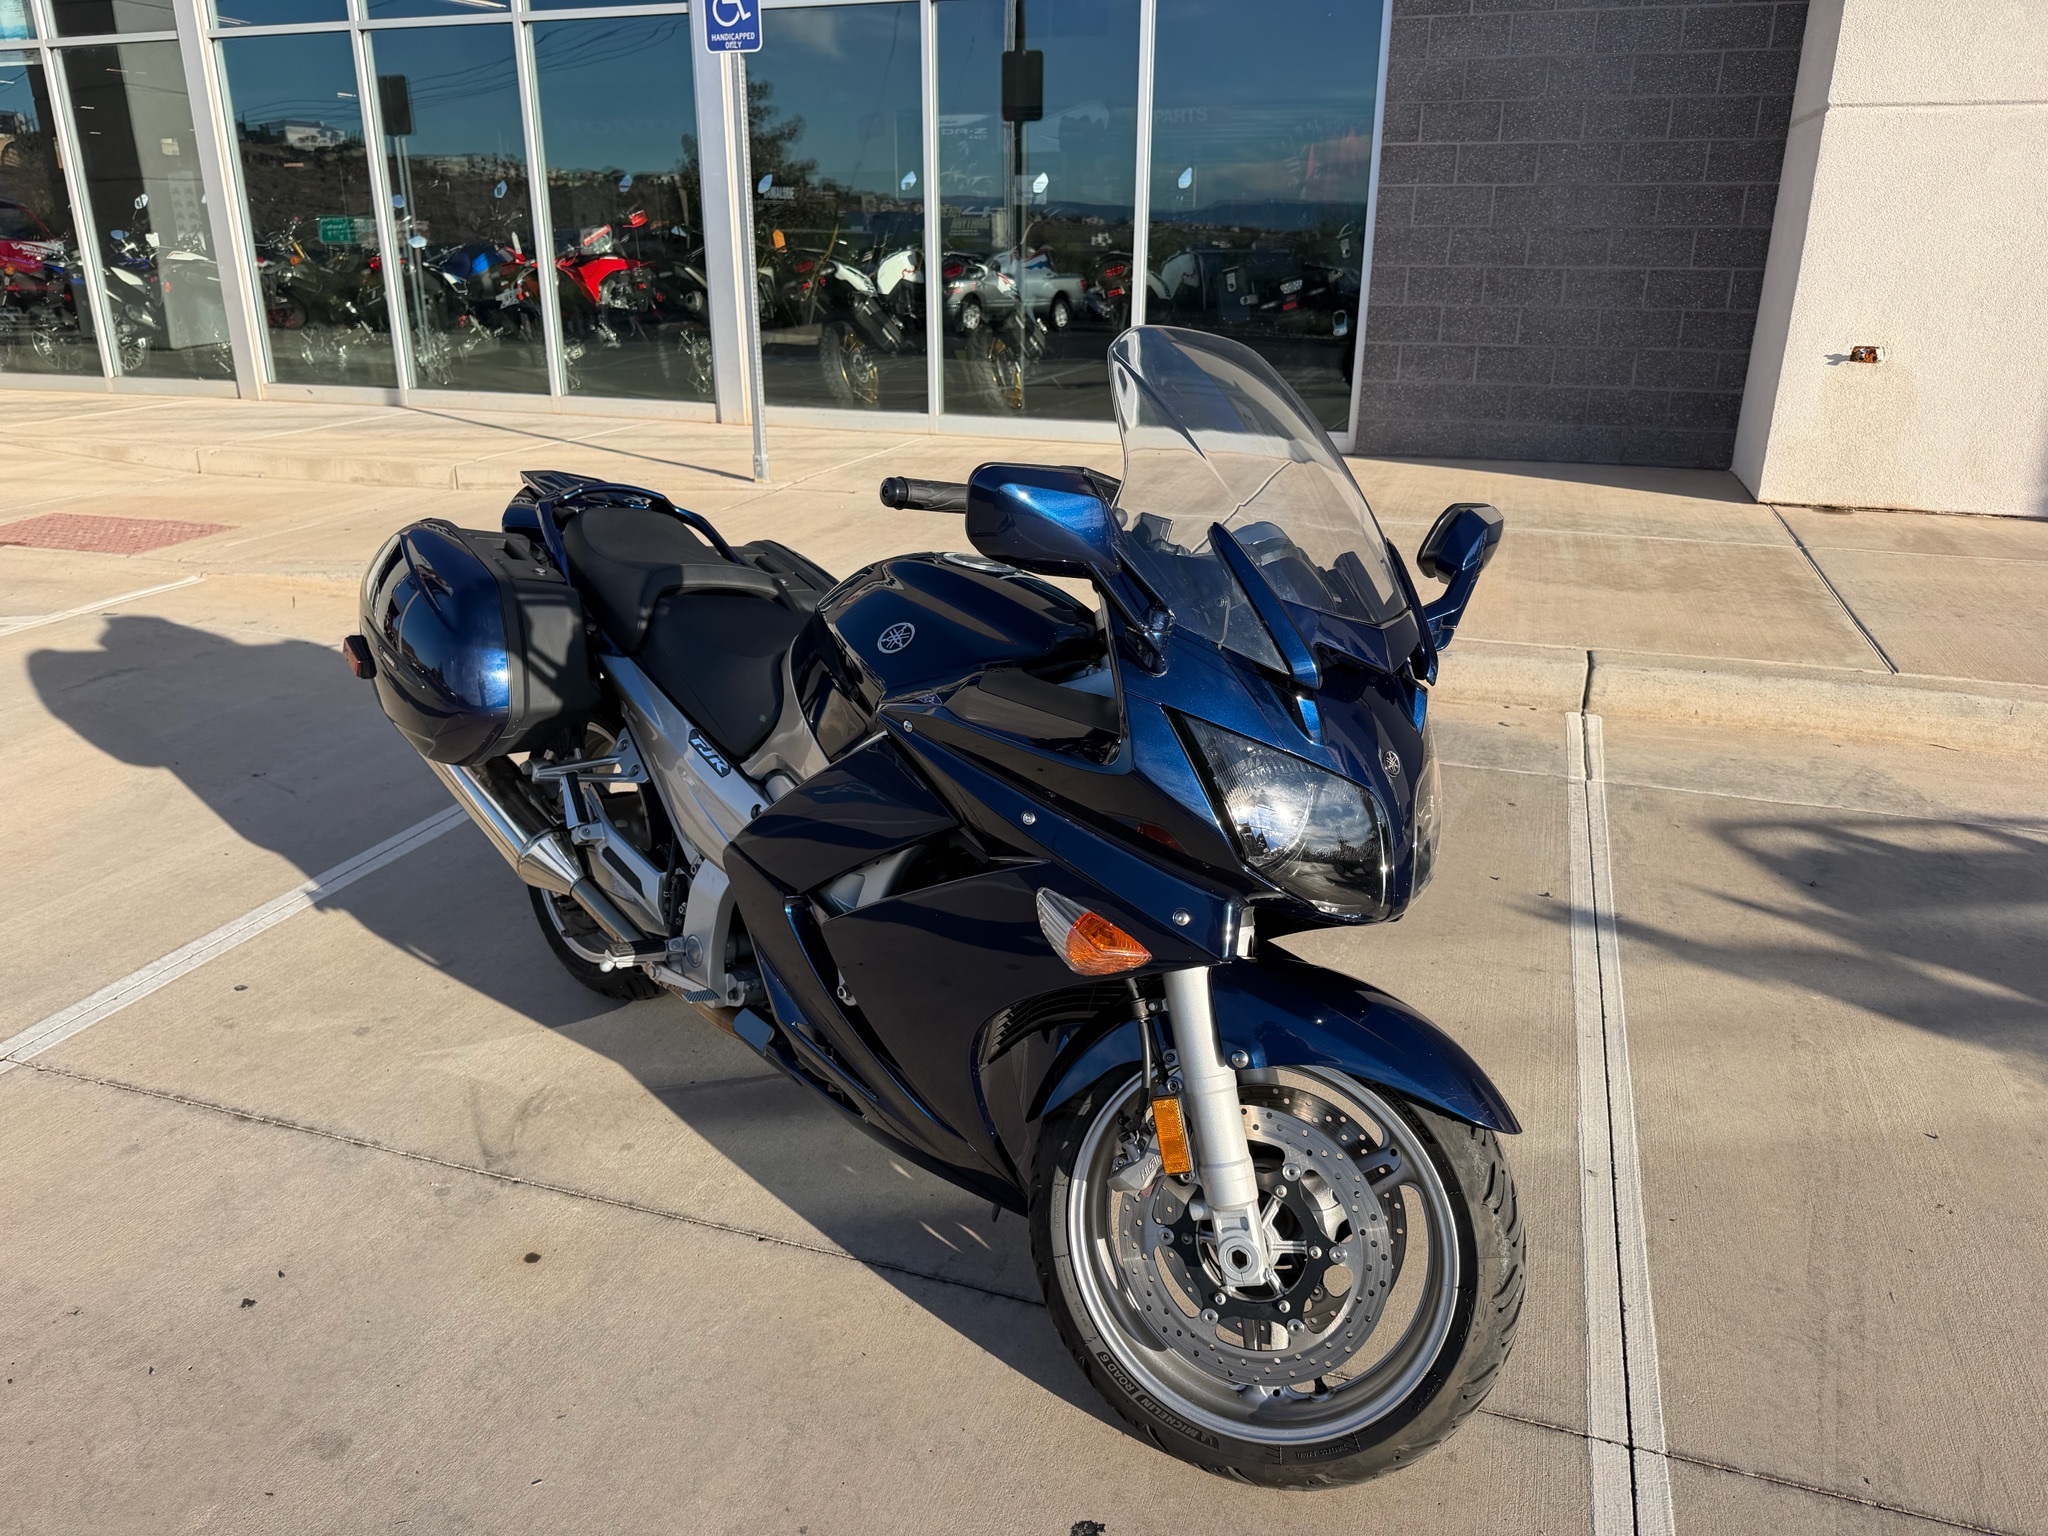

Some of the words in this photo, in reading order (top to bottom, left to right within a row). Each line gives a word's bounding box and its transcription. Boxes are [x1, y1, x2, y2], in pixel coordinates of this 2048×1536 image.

[711, 32, 755, 41] HANDICAPPED
[725, 41, 742, 49] ONLY
[1154, 106, 1208, 123] PARTS
[1100, 1352, 1109, 1361] 6
[1107, 1361, 1135, 1393] ROAD
[1140, 1397, 1199, 1438] MICHELIN
